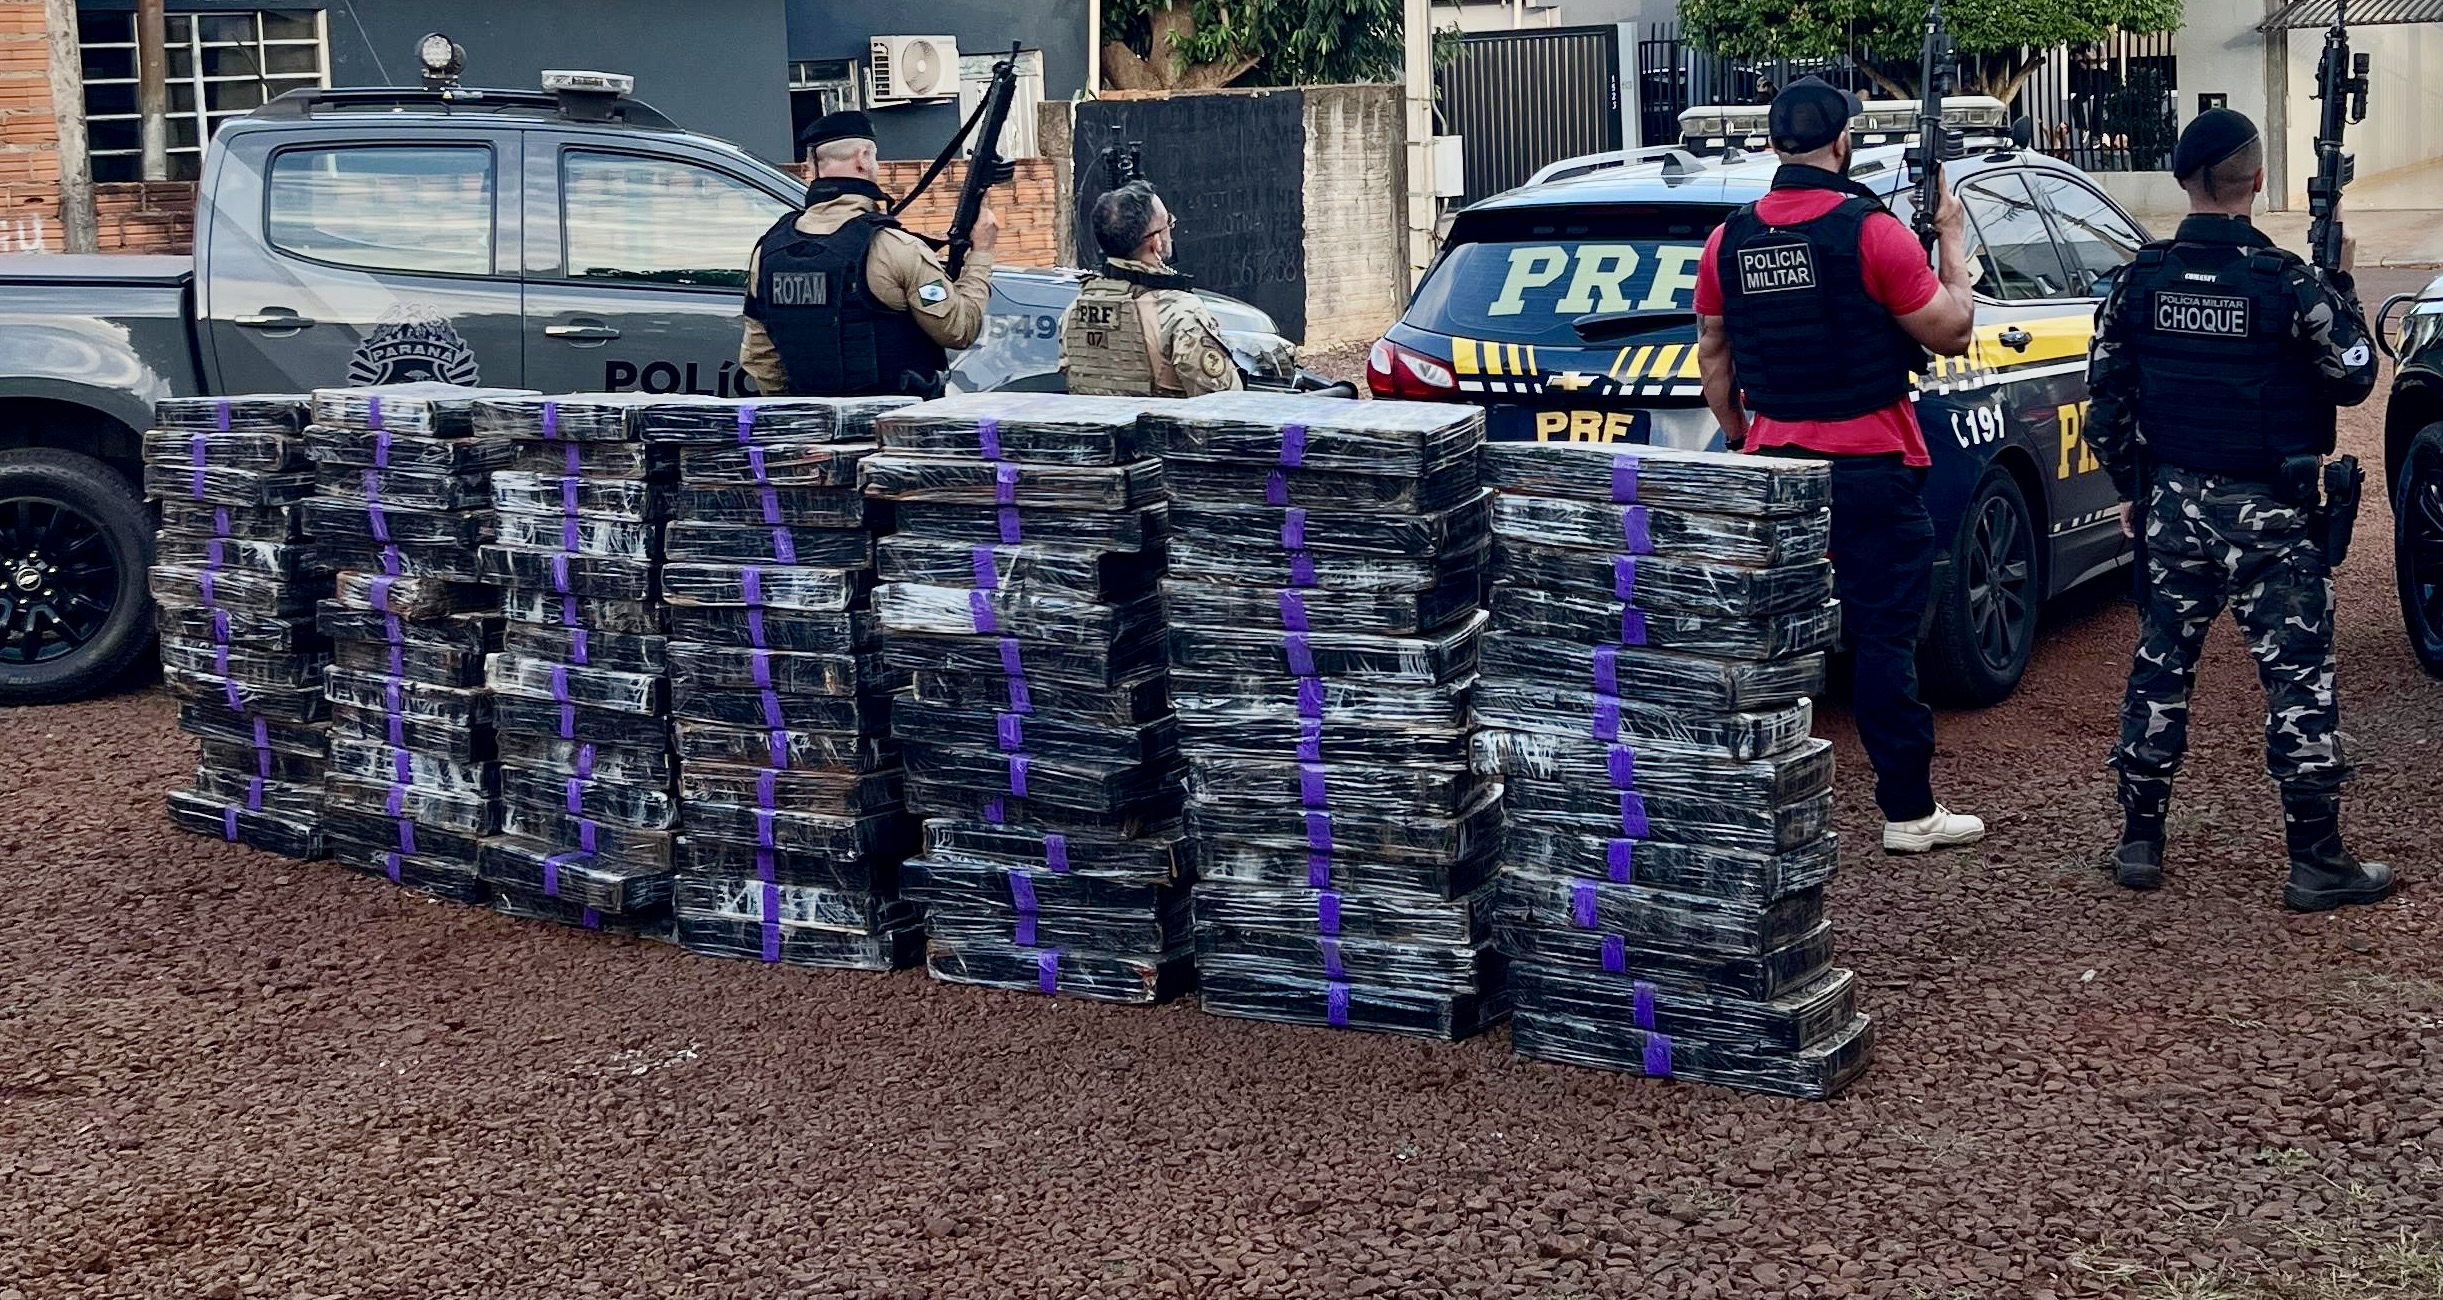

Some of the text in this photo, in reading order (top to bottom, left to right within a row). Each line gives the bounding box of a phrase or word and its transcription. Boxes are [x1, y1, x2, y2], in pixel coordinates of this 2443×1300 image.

[1744, 248, 1807, 271] POLÍCIA
[773, 275, 826, 304] ROTAM
[1488, 244, 1706, 316] PRF
[1746, 267, 1811, 289] MILITAR
[2160, 294, 2244, 309] POLÍCIA MILITAR
[1080, 305, 1113, 324] PRF
[2159, 305, 2244, 333] CHOQUE
[372, 344, 454, 361] PARANÁ
[1536, 410, 1634, 443] PRF
[1966, 404, 2005, 445] 191
